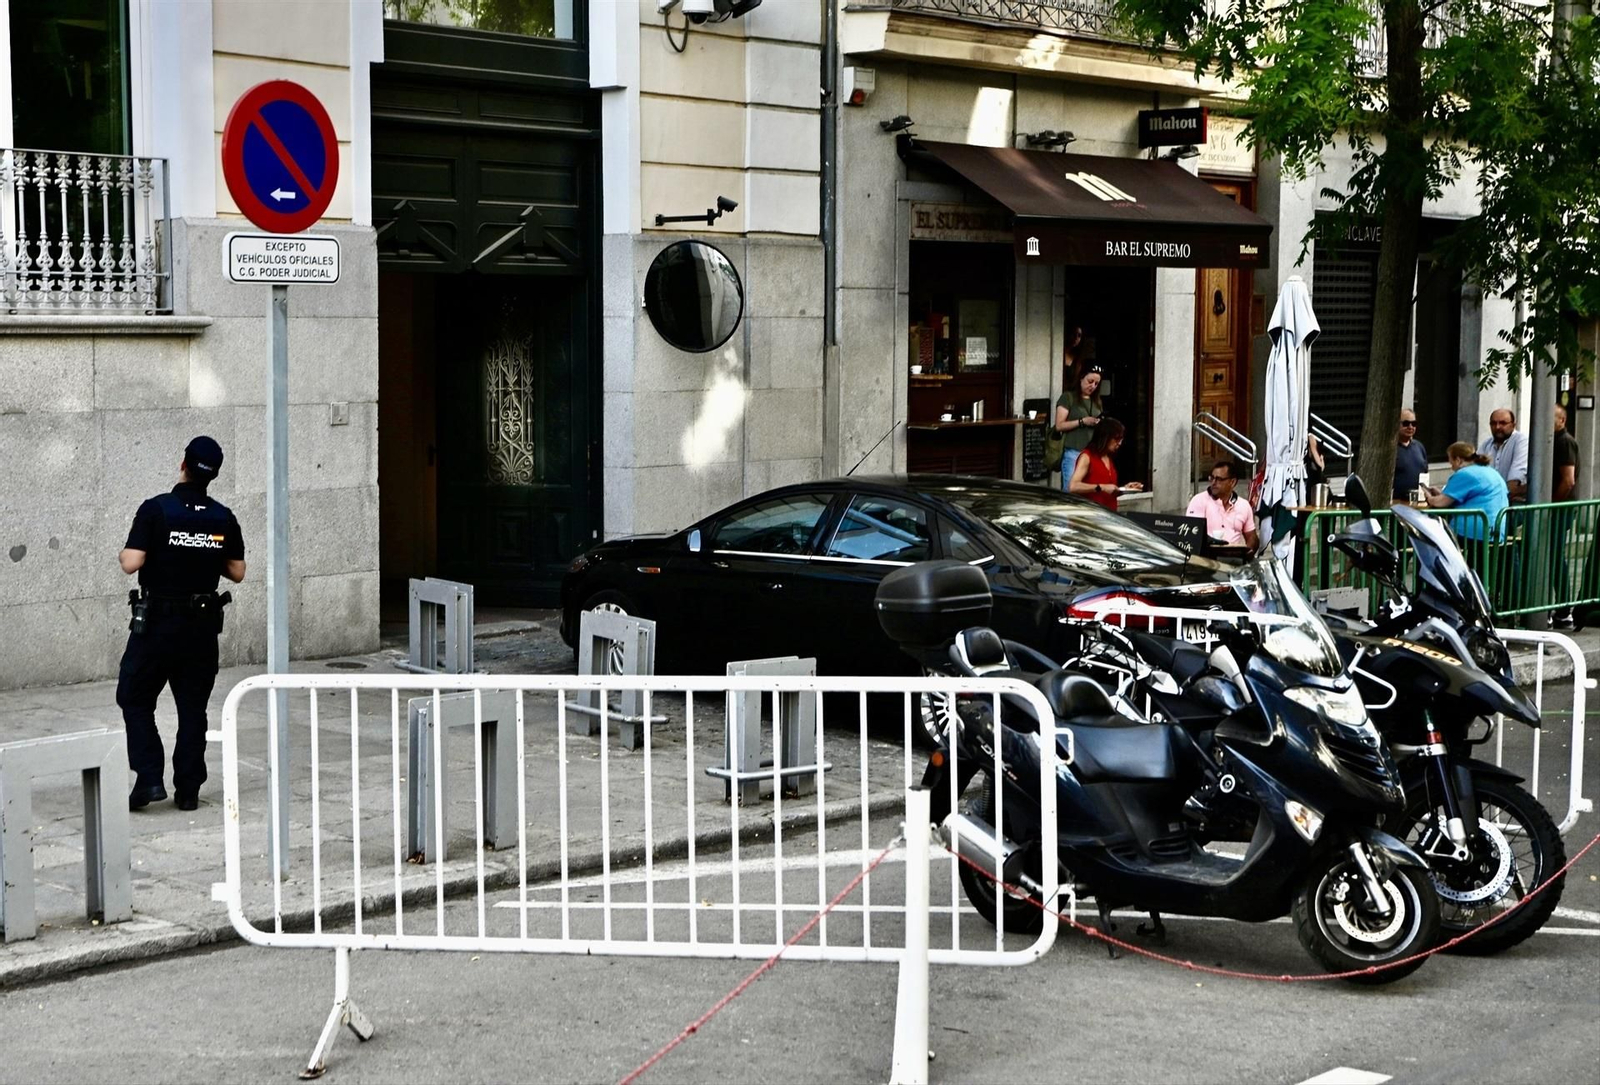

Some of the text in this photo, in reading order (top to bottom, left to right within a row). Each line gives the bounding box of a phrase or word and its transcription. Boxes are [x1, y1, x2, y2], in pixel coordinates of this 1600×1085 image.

[1149, 115, 1197, 131] Mahou
[915, 211, 934, 229] EL
[265, 241, 307, 252] EXCEPTO
[1105, 240, 1191, 259] BAR EL SUPREMO
[1239, 244, 1259, 254] Mahou
[236, 253, 334, 266] VEHÍCULOS OFICIALES
[239, 267, 331, 278] C.G. PODER JUDICIAL
[169, 531, 214, 541] POLICIA
[168, 538, 223, 549] NACIONAL
[1381, 637, 1463, 667] R1200
